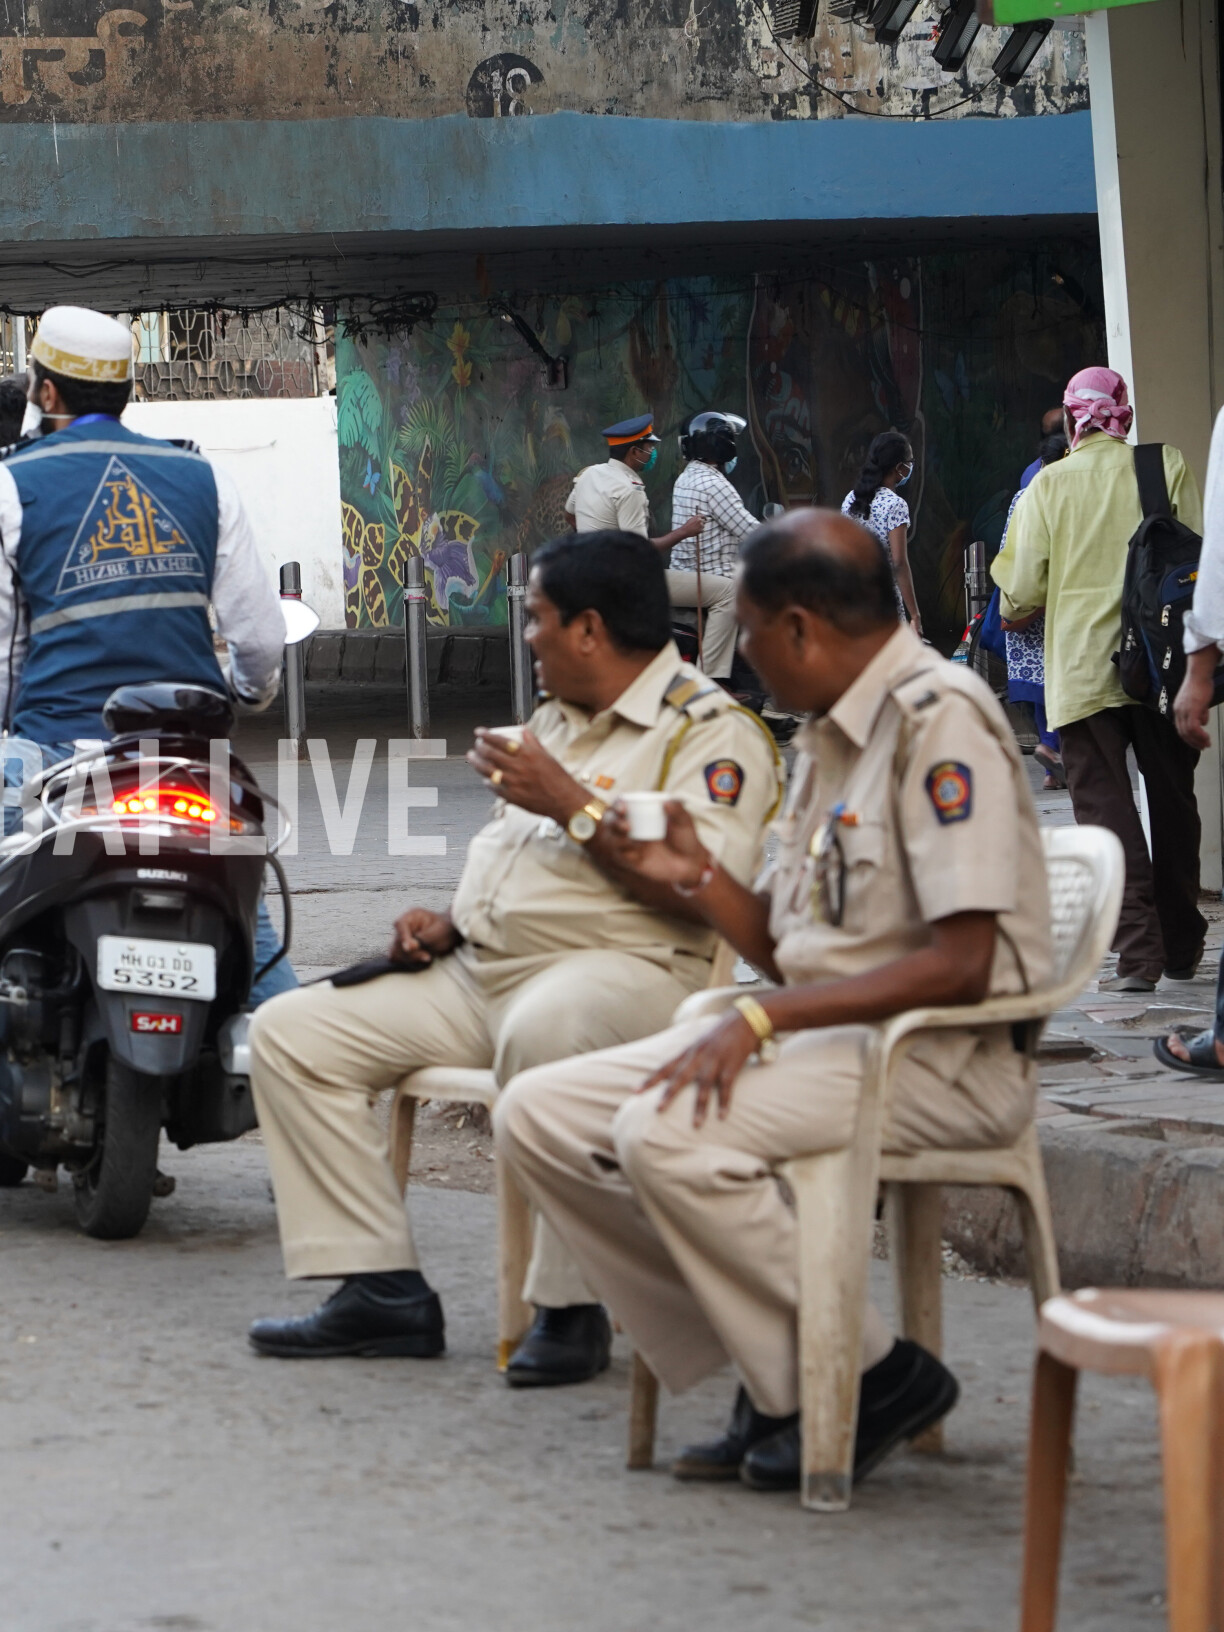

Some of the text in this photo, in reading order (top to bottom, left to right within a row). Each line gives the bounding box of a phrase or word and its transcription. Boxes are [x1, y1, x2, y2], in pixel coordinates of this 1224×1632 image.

[75, 557, 194, 585] HIZBE FAKHRI
[137, 868, 188, 882] SUZUKI
[120, 953, 142, 966] MH
[113, 968, 199, 993] 5352
